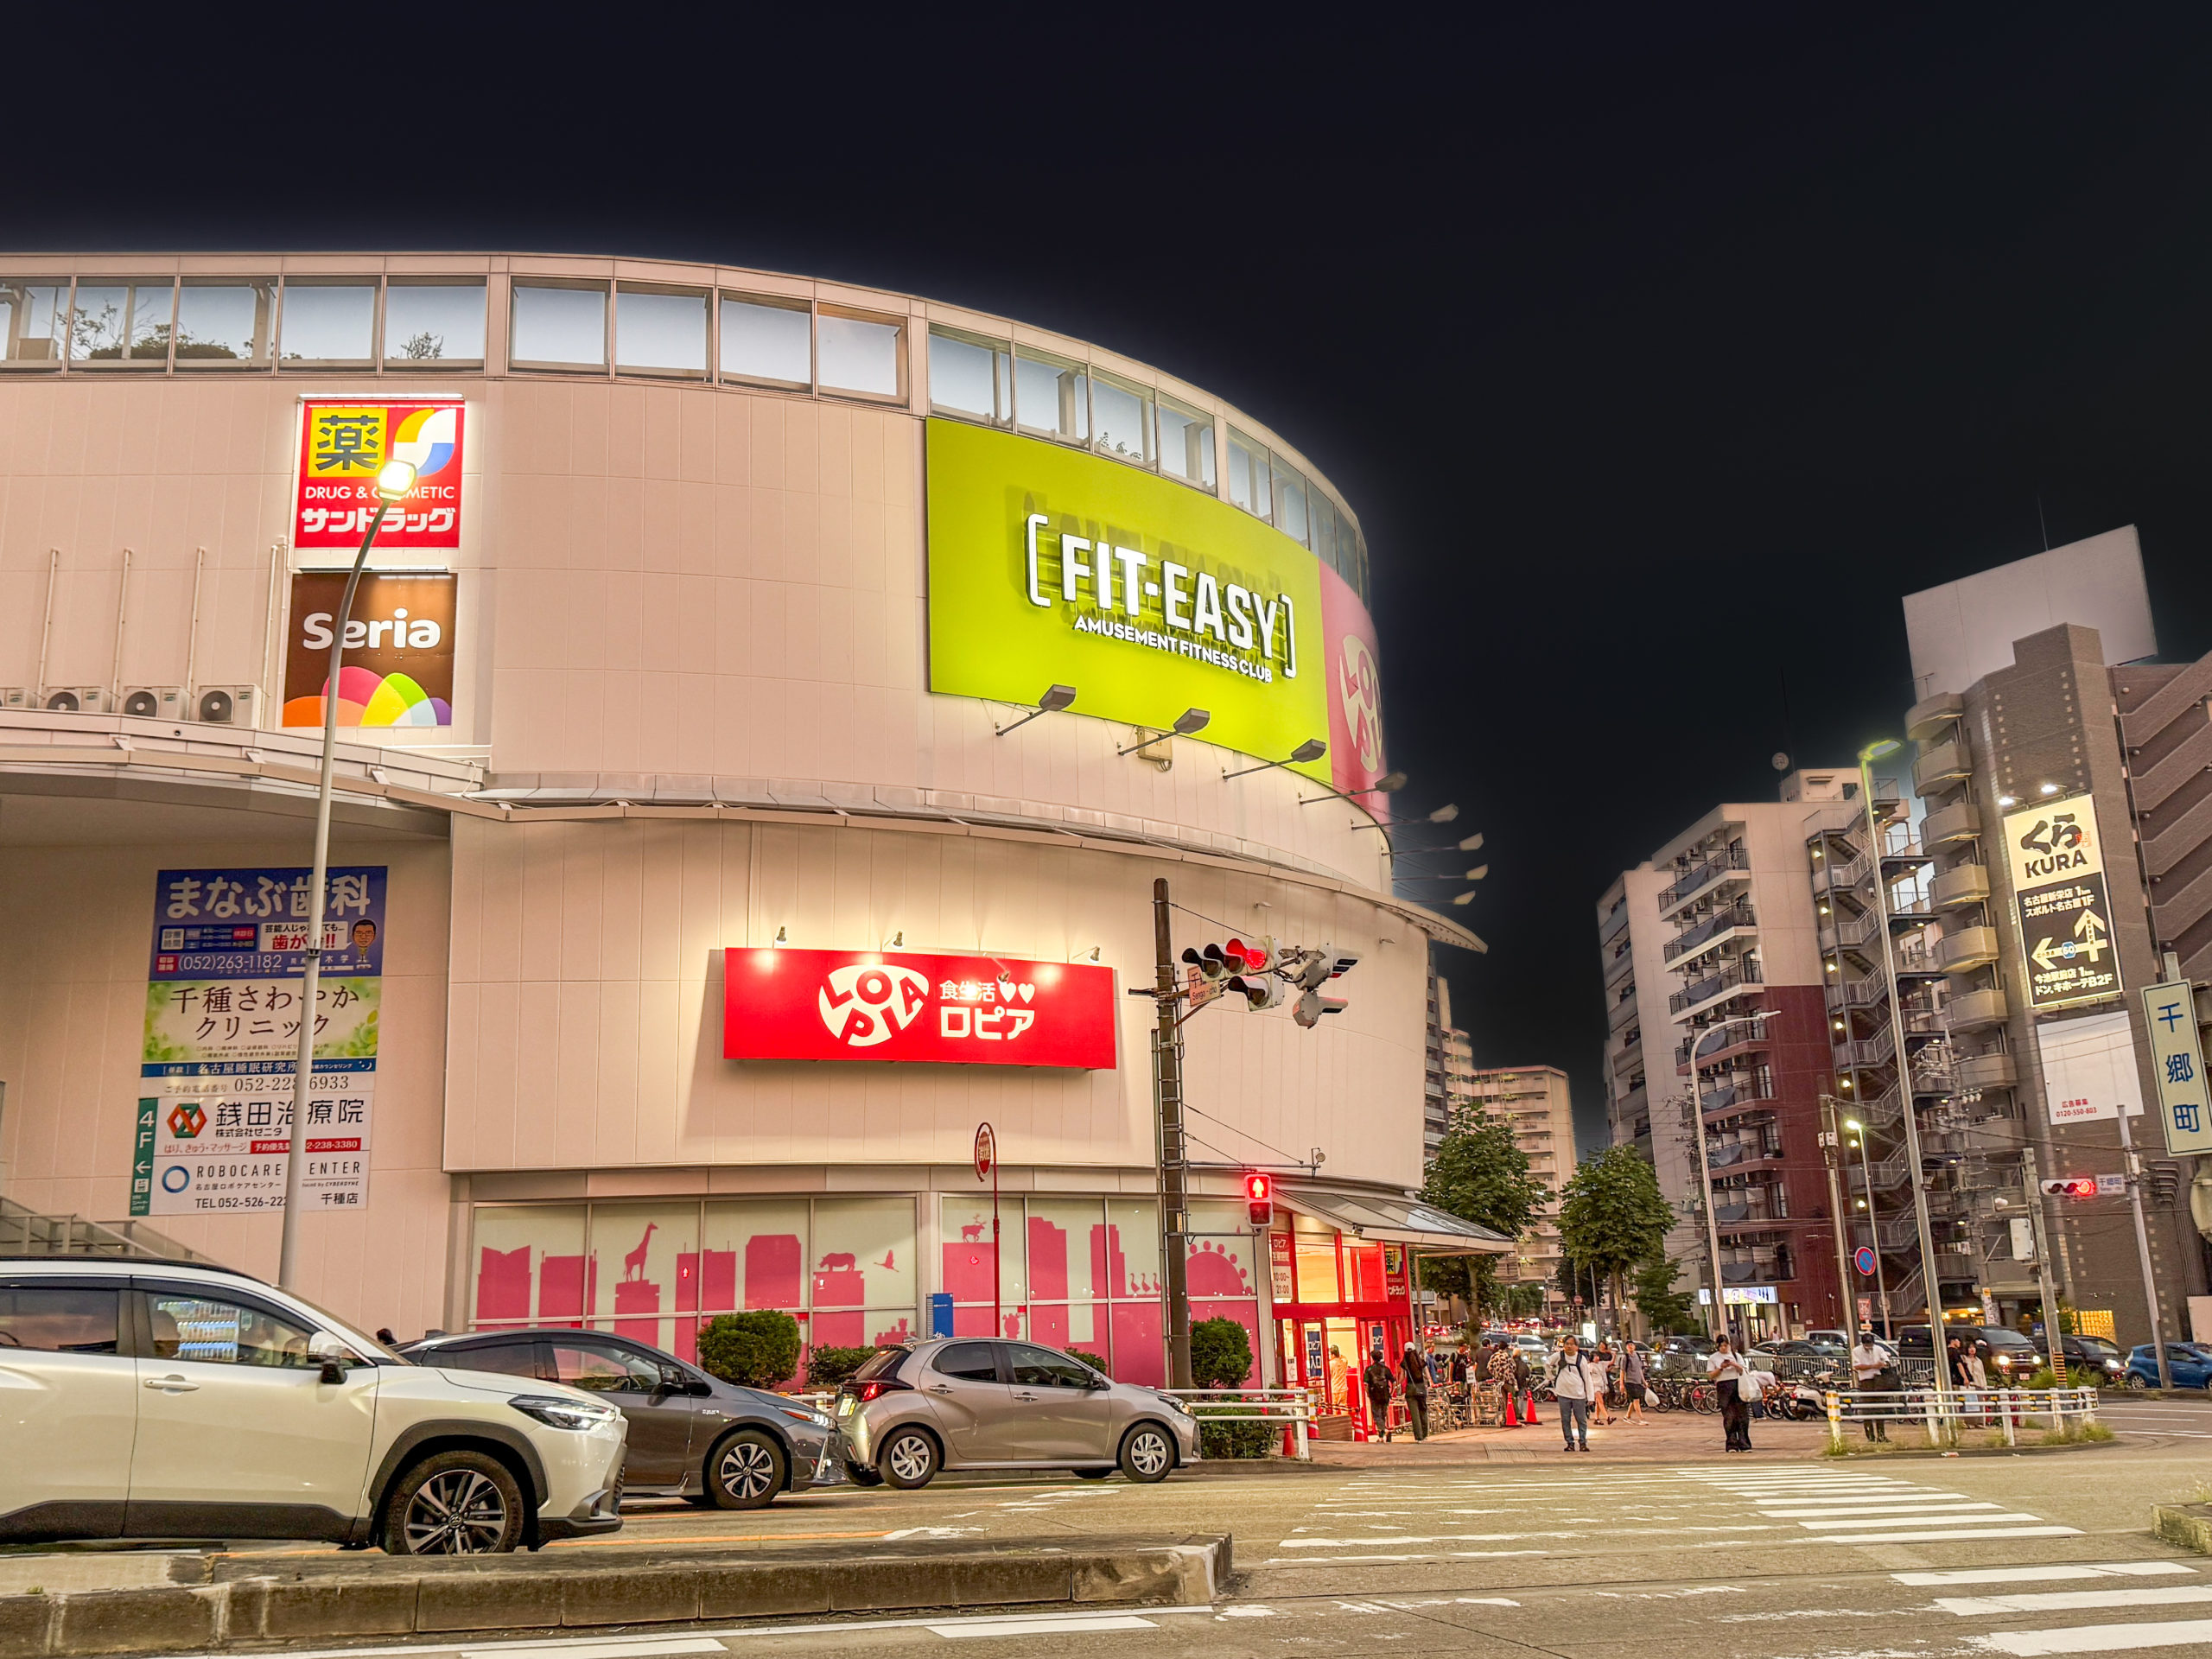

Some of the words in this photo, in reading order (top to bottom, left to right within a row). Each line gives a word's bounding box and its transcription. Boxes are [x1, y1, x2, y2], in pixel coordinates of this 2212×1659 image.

[315, 415, 380, 471] 薬
[305, 486, 352, 499] DRUG
[356, 486, 369, 499] &
[301, 507, 456, 533] サンドラッグ
[302, 607, 442, 650] Seria
[1074, 615, 1179, 654] AMUSEMENT
[1179, 638, 1239, 671] FITNESS
[1238, 658, 1274, 683] CLUB
[2020, 813, 2082, 855] くら
[2024, 849, 2088, 879] KURA
[167, 874, 372, 919] まなぶ歯科
[272, 933, 336, 950] 歯が!!
[178, 954, 283, 971] (052)263-1182
[170, 985, 359, 1014] 千種さわやか
[818, 964, 930, 1047] LOPIA
[195, 1014, 331, 1041] クリニック
[940, 1006, 1035, 1040] ロピア
[198, 1062, 297, 1075] 名古屋睡眠研究所
[2158, 1002, 2201, 1133] 千郷町
[216, 1099, 365, 1127] 銭田治療院
[215, 1128, 283, 1138] 株式会社ゼニタ
[197, 1164, 282, 1178] ROBOCARE
[309, 1161, 360, 1174] ENTER
[195, 1198, 216, 1208] TEL
[321, 1192, 359, 1205] 千種店
[1310, 1355, 1321, 1370] 入口
